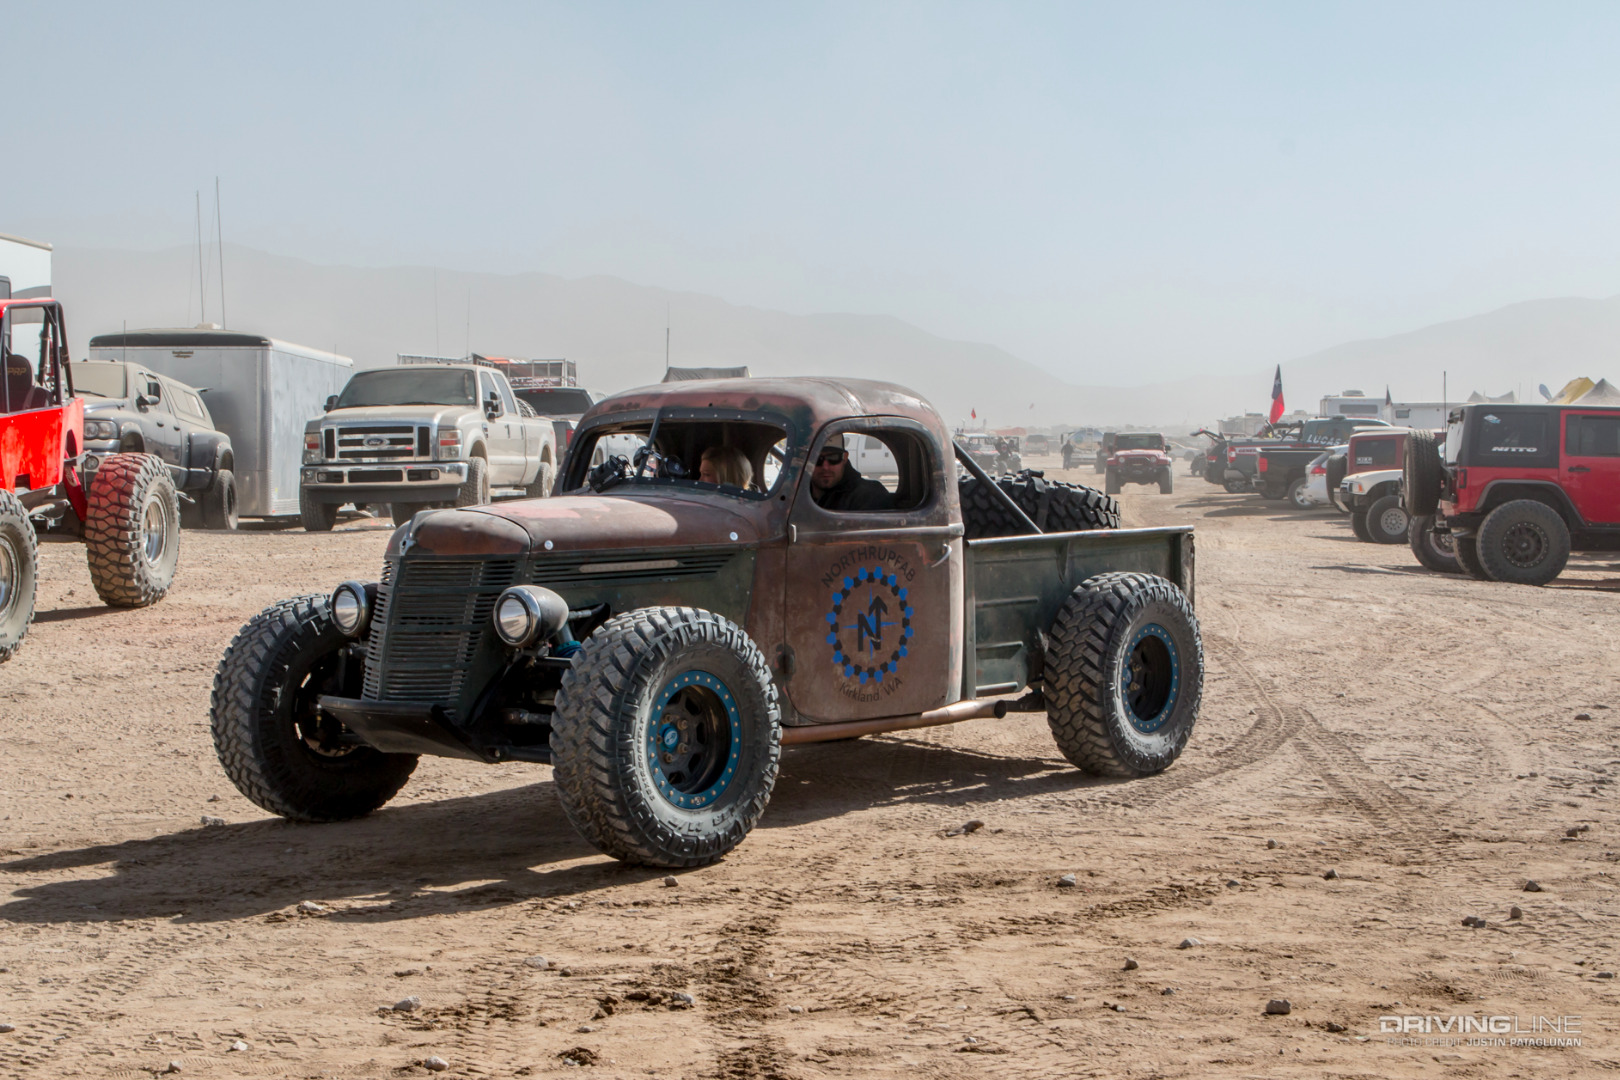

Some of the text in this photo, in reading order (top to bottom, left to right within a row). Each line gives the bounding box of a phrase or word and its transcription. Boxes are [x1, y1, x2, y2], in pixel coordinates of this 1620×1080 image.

[1306, 434, 1341, 446] LUCAS
[821, 546, 916, 588] NORTHRUPFAB
[884, 677, 902, 696] WA
